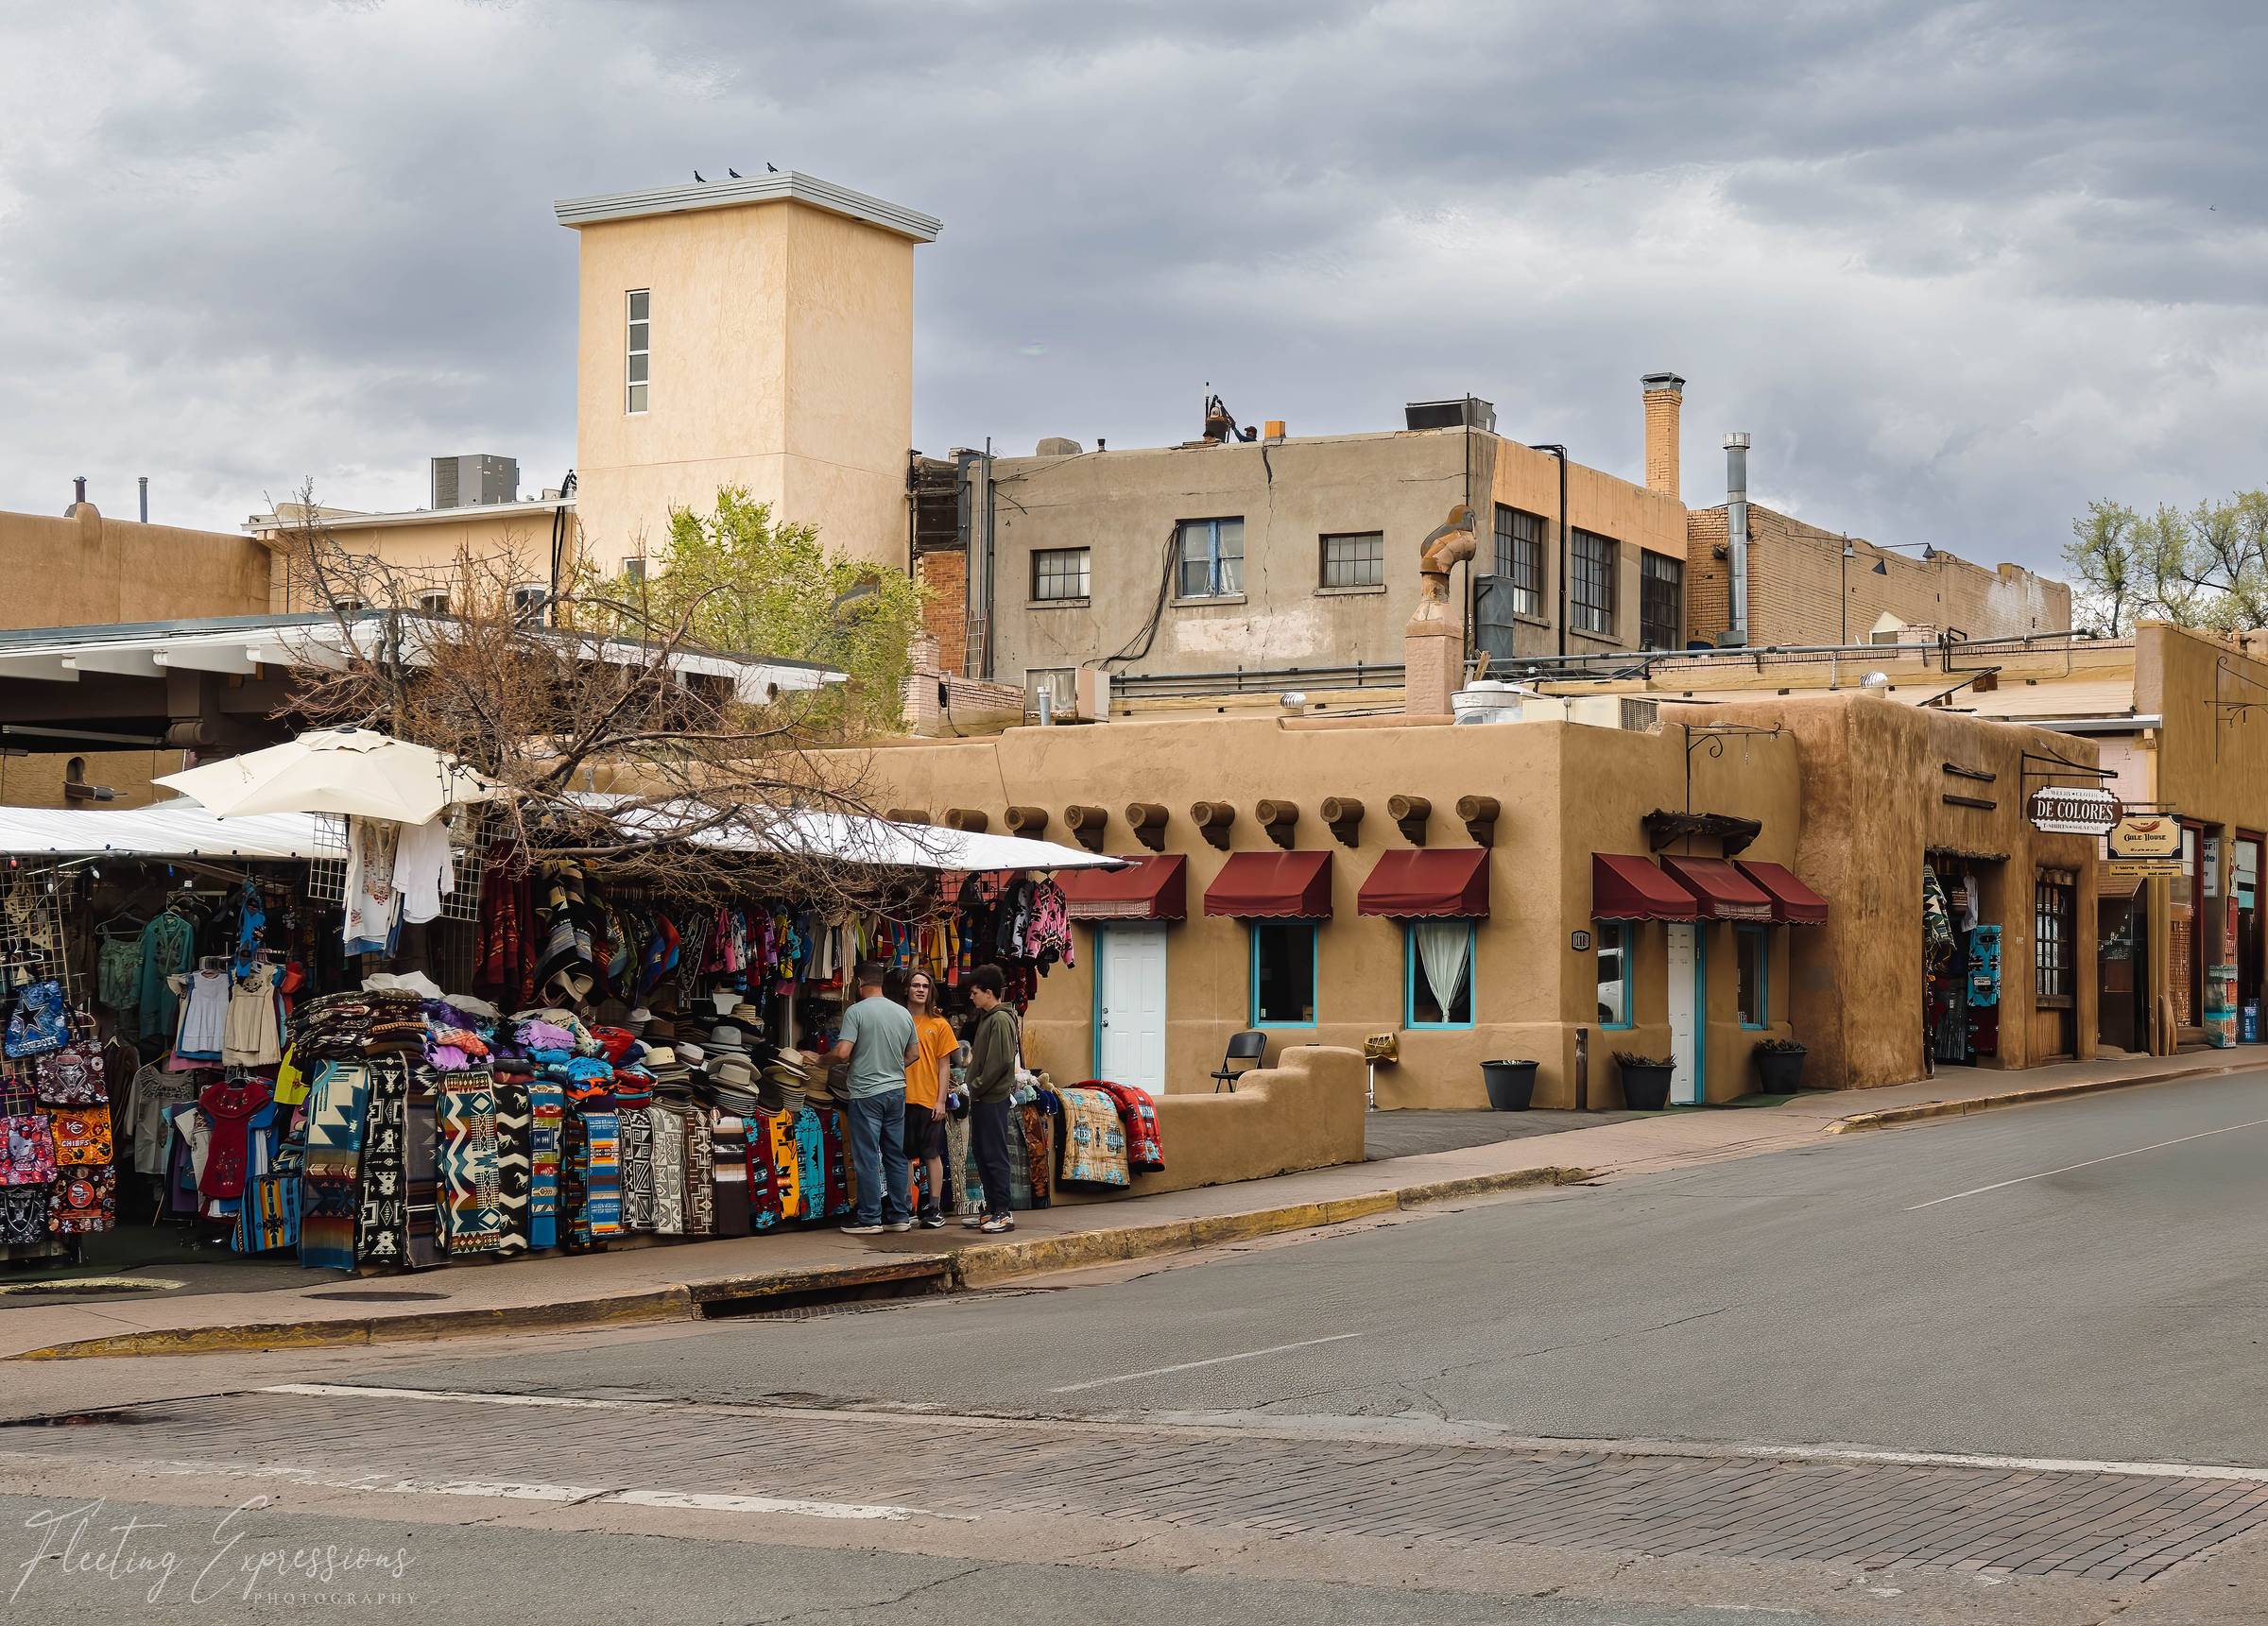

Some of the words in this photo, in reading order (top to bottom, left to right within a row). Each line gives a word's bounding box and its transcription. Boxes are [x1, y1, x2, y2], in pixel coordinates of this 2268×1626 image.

[2036, 800, 2053, 817] DE
[2057, 801, 2114, 821] COLORES
[2143, 833, 2167, 842] HOUSE
[18, 1036, 58, 1052] COWBOYS
